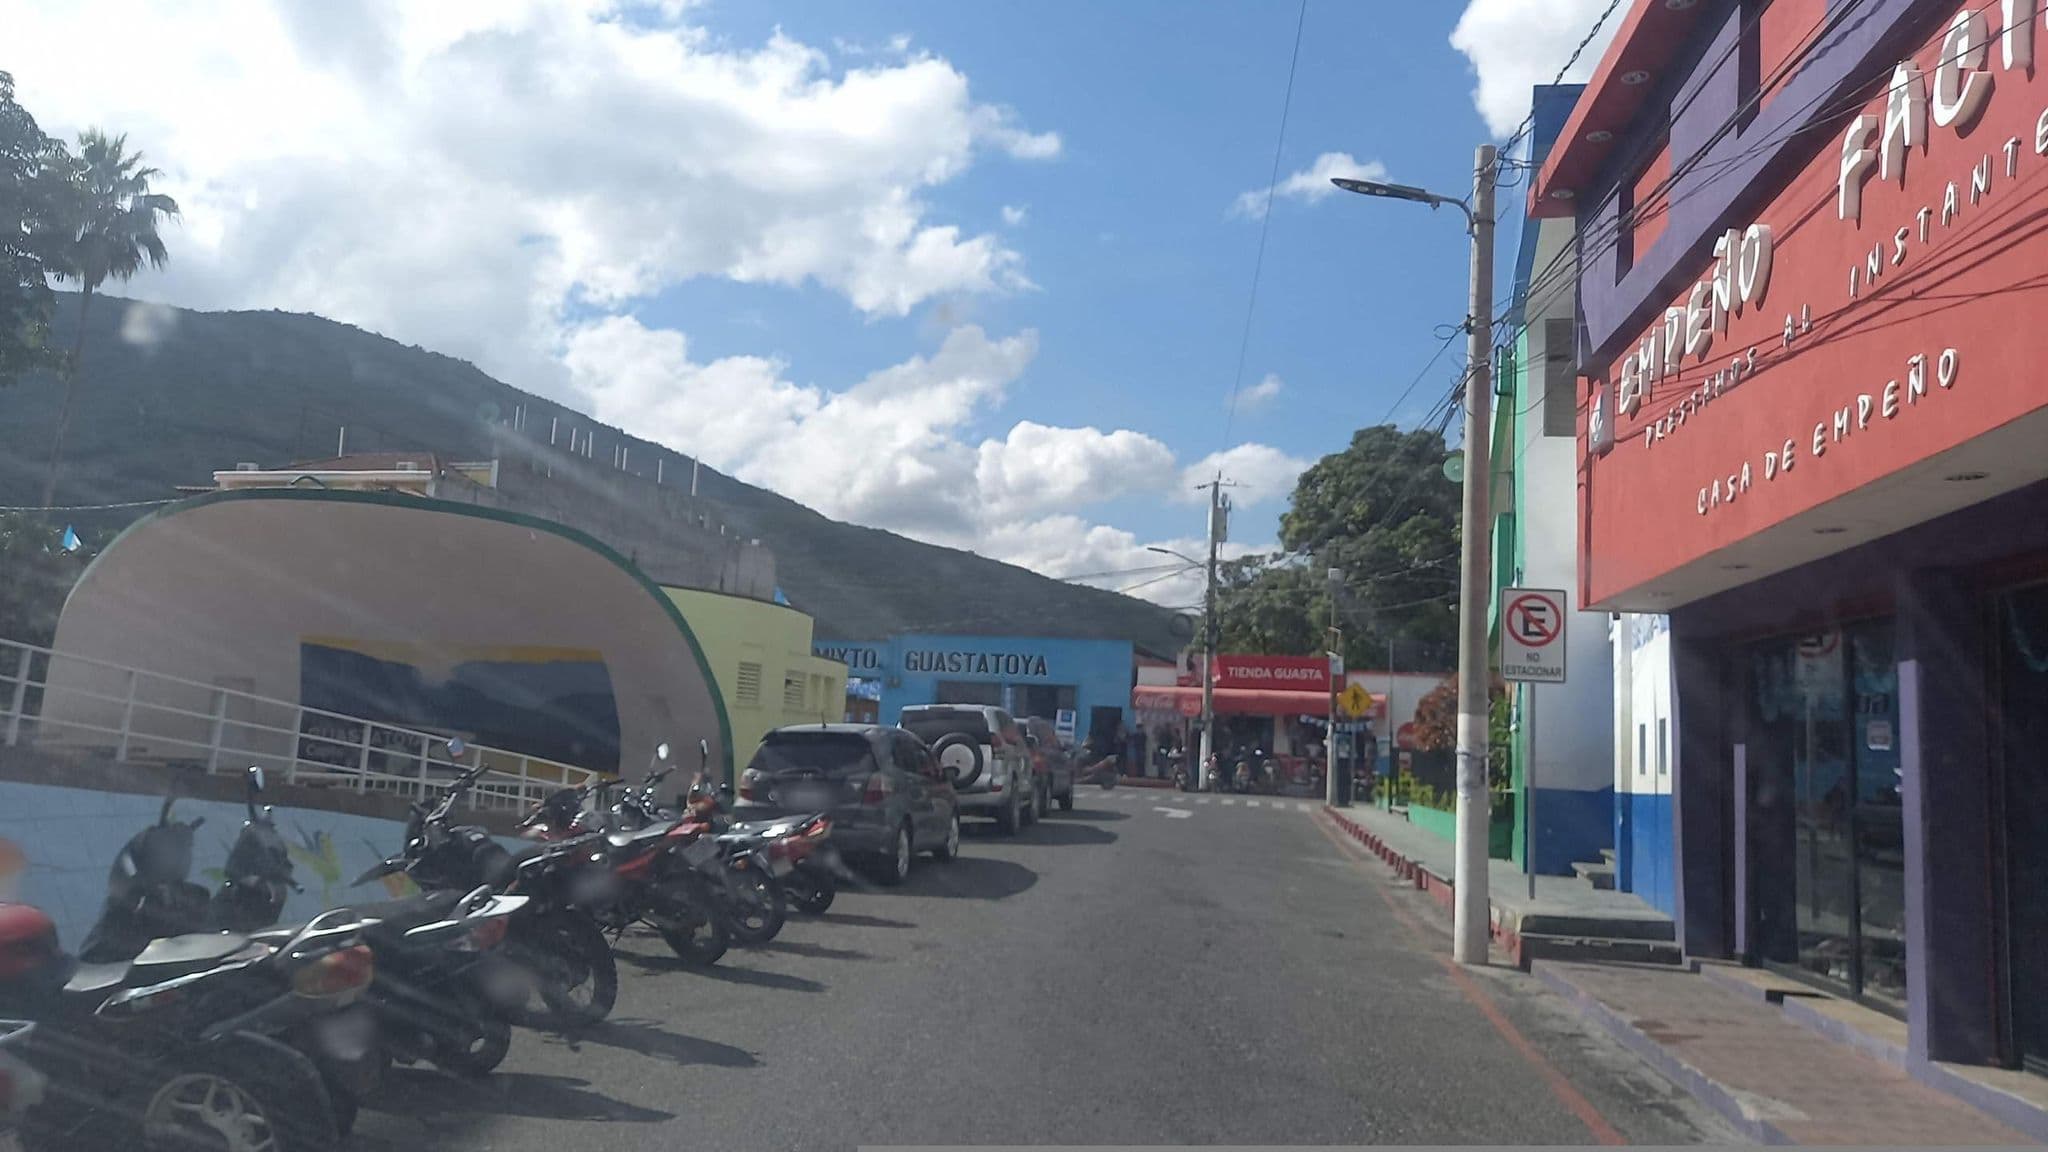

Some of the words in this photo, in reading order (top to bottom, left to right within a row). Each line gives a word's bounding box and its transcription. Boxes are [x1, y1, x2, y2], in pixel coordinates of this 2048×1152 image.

[1619, 224, 1773, 415] EMPEÑO
[1837, 0, 2048, 220] FACI
[1783, 303, 1814, 350] AL
[1697, 462, 1752, 514] CASA
[1765, 439, 1796, 480] DE
[1812, 348, 1960, 456] EMPEÑO
[904, 650, 1048, 676] GUASTATOYA
[1526, 652, 1540, 663] NO
[1227, 666, 1271, 679] TIENDA
[1274, 668, 1324, 681] GUASTA
[1505, 664, 1562, 678] ESTACIONAR
